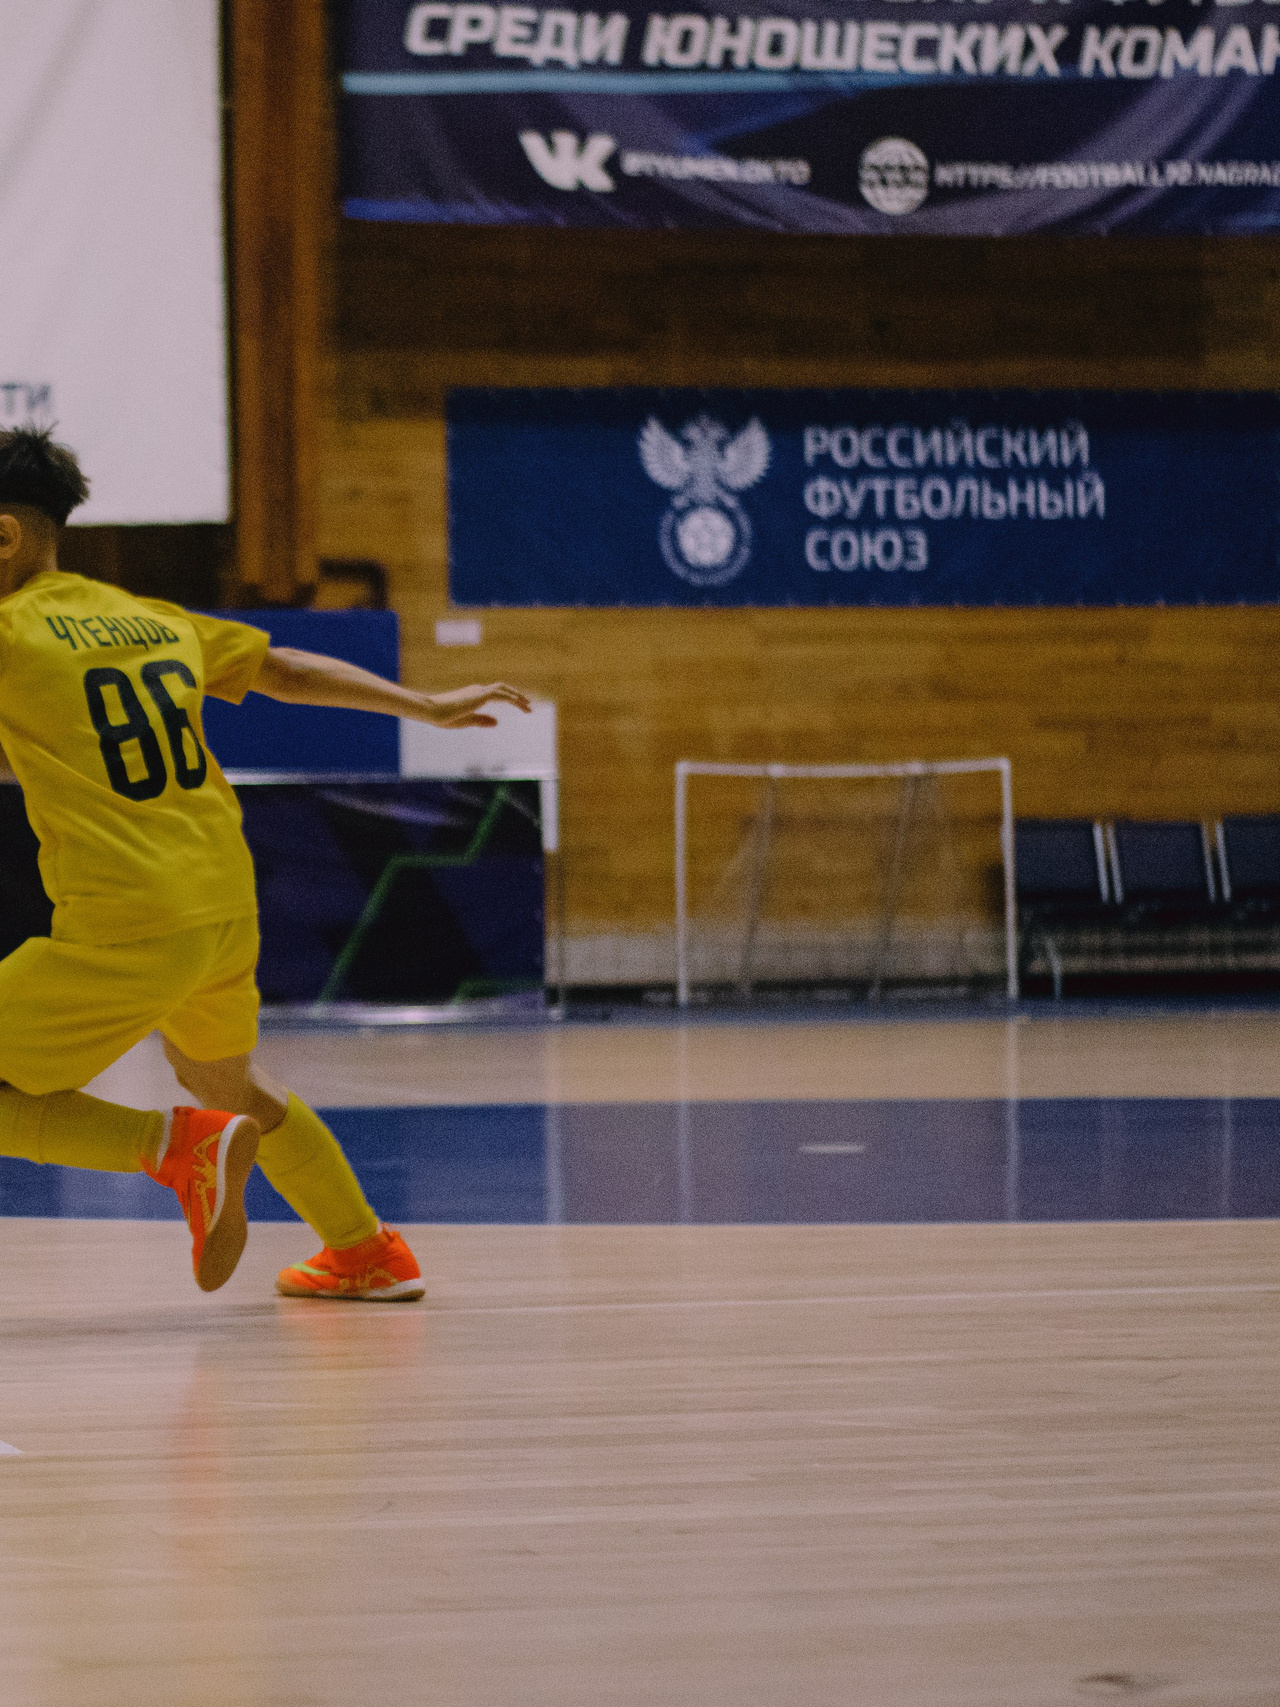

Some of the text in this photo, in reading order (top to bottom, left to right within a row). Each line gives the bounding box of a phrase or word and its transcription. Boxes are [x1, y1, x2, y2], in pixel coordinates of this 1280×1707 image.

[405, 3, 629, 69] СРЕДИ
[642, 13, 1068, 78] ЮНОШЕСКИХ
[804, 418, 1091, 469] РОССИЙСКИЙ
[804, 469, 1105, 520] ФУТБОЛЬНЫЙ
[804, 528, 929, 572] СОЮЗ
[45, 615, 181, 651] ЧТЕНЦОВ
[83, 659, 207, 802] 86
